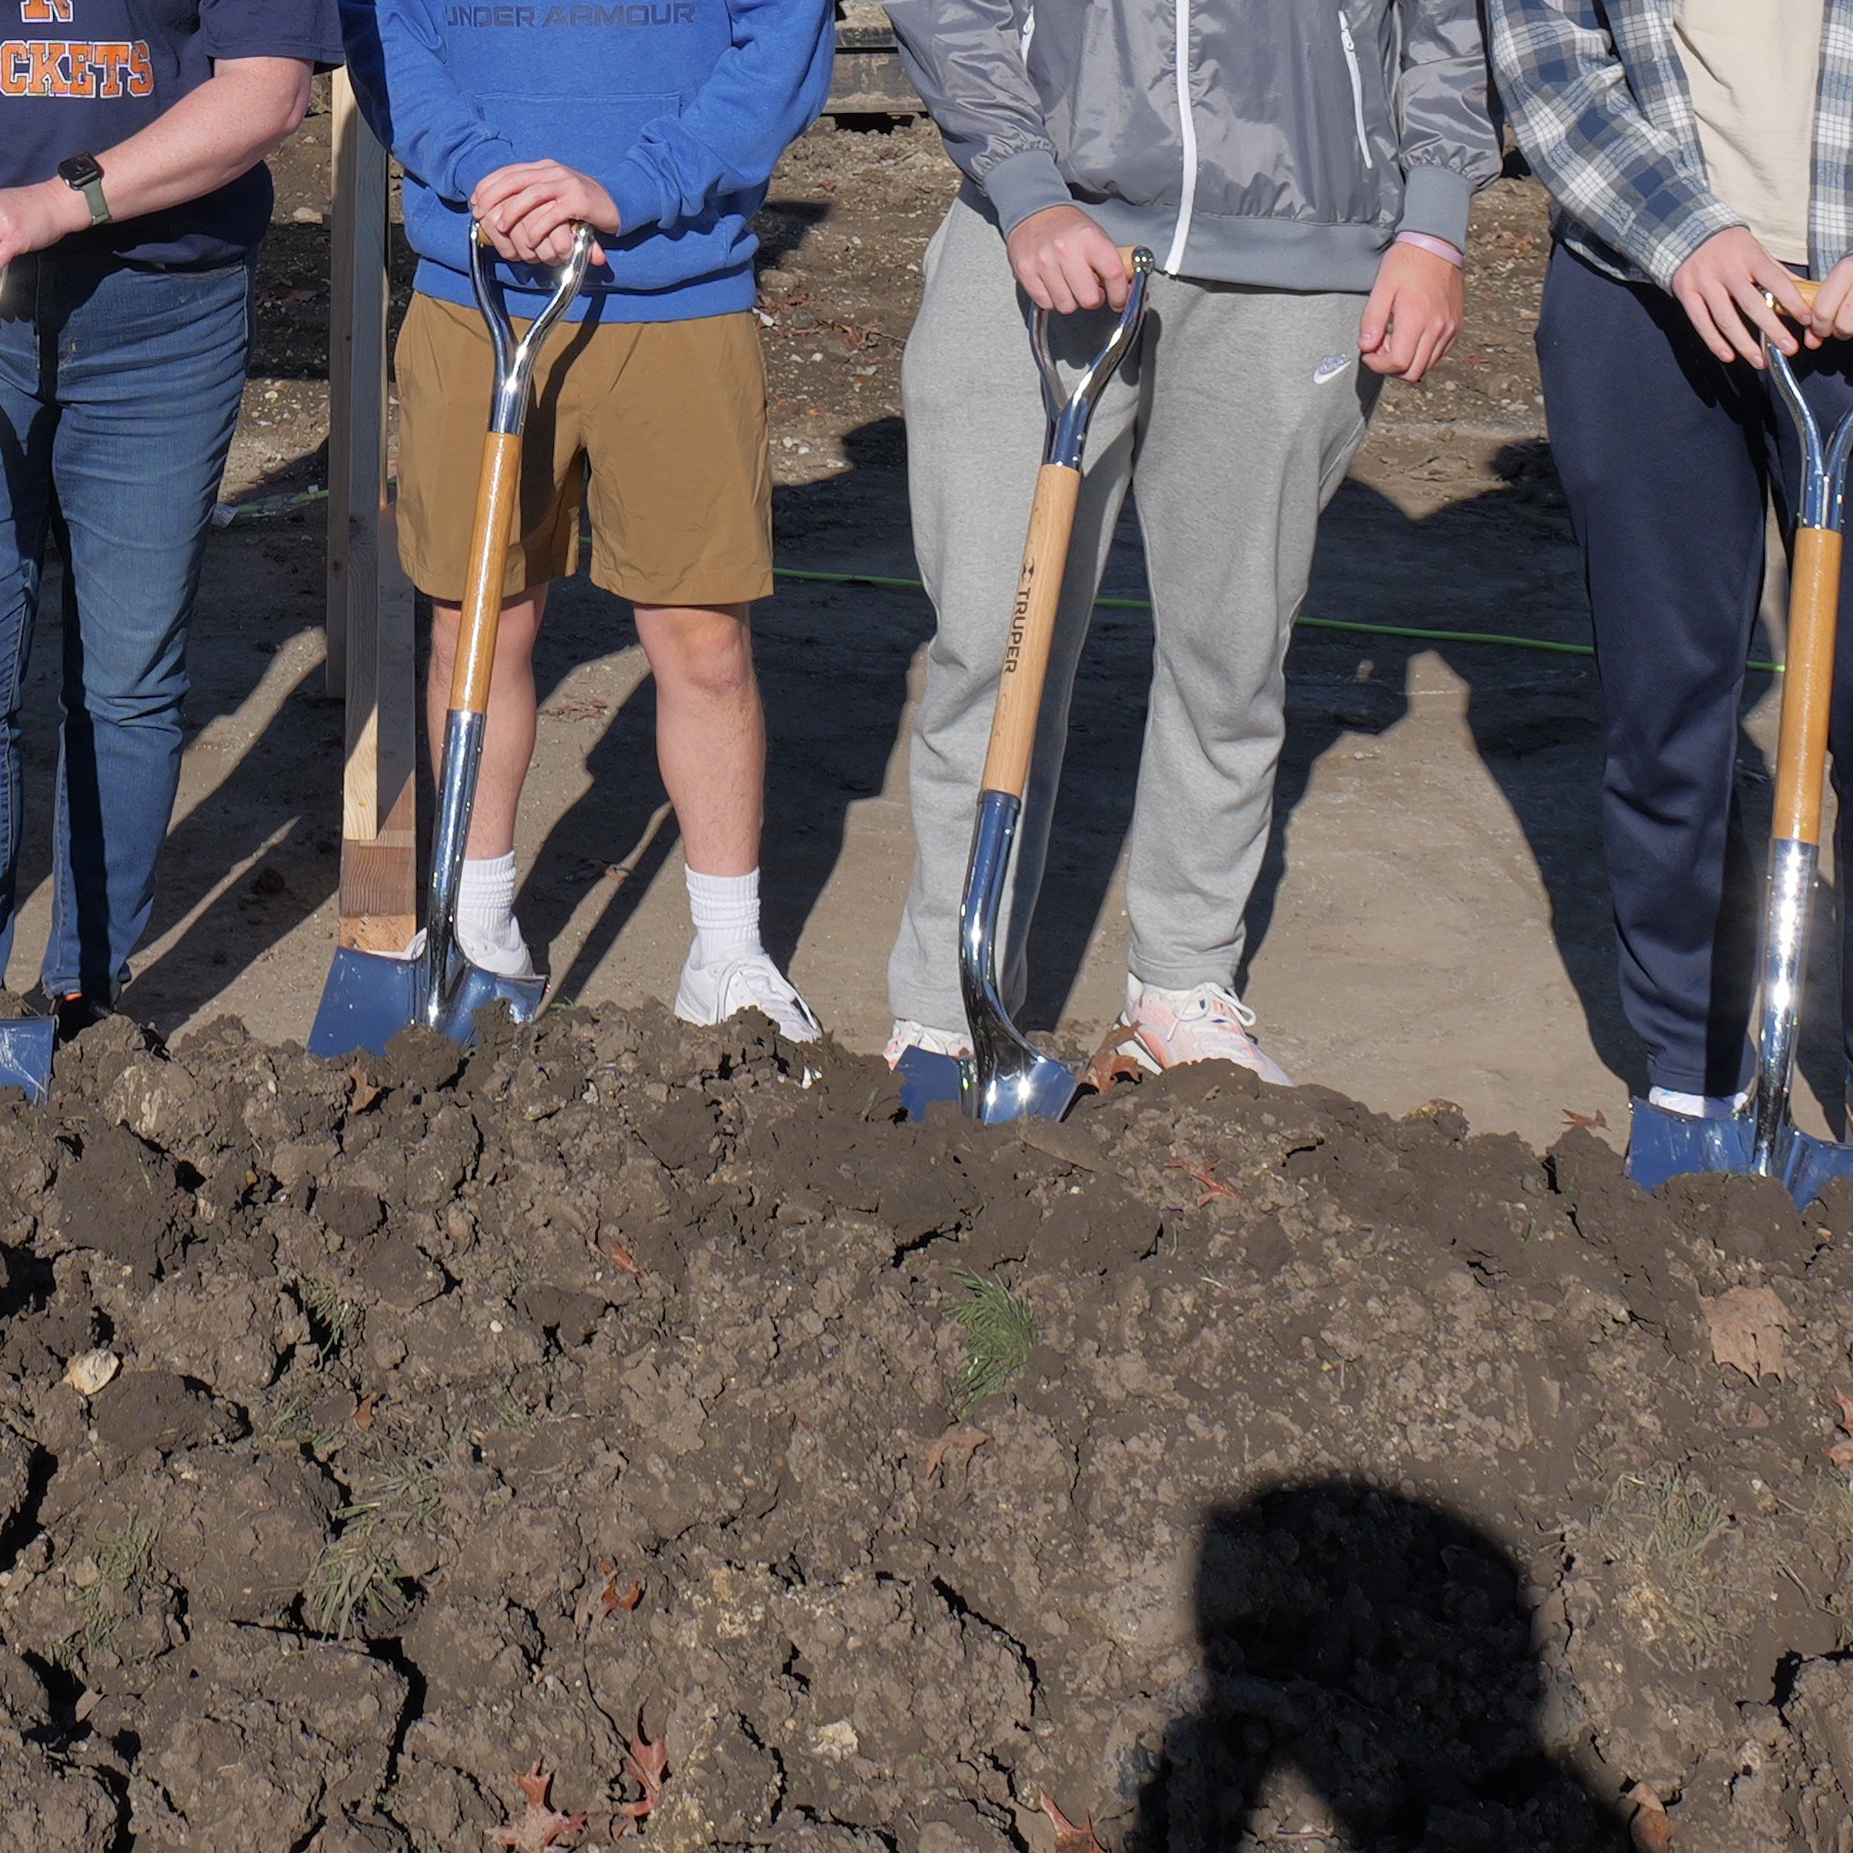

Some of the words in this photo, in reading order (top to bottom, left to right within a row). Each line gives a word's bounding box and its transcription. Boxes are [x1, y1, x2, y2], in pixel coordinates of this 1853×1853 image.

[445, 5, 535, 28] UNDER
[542, 2, 696, 29] ARMOUR
[1004, 586, 1031, 675] TRUPER
